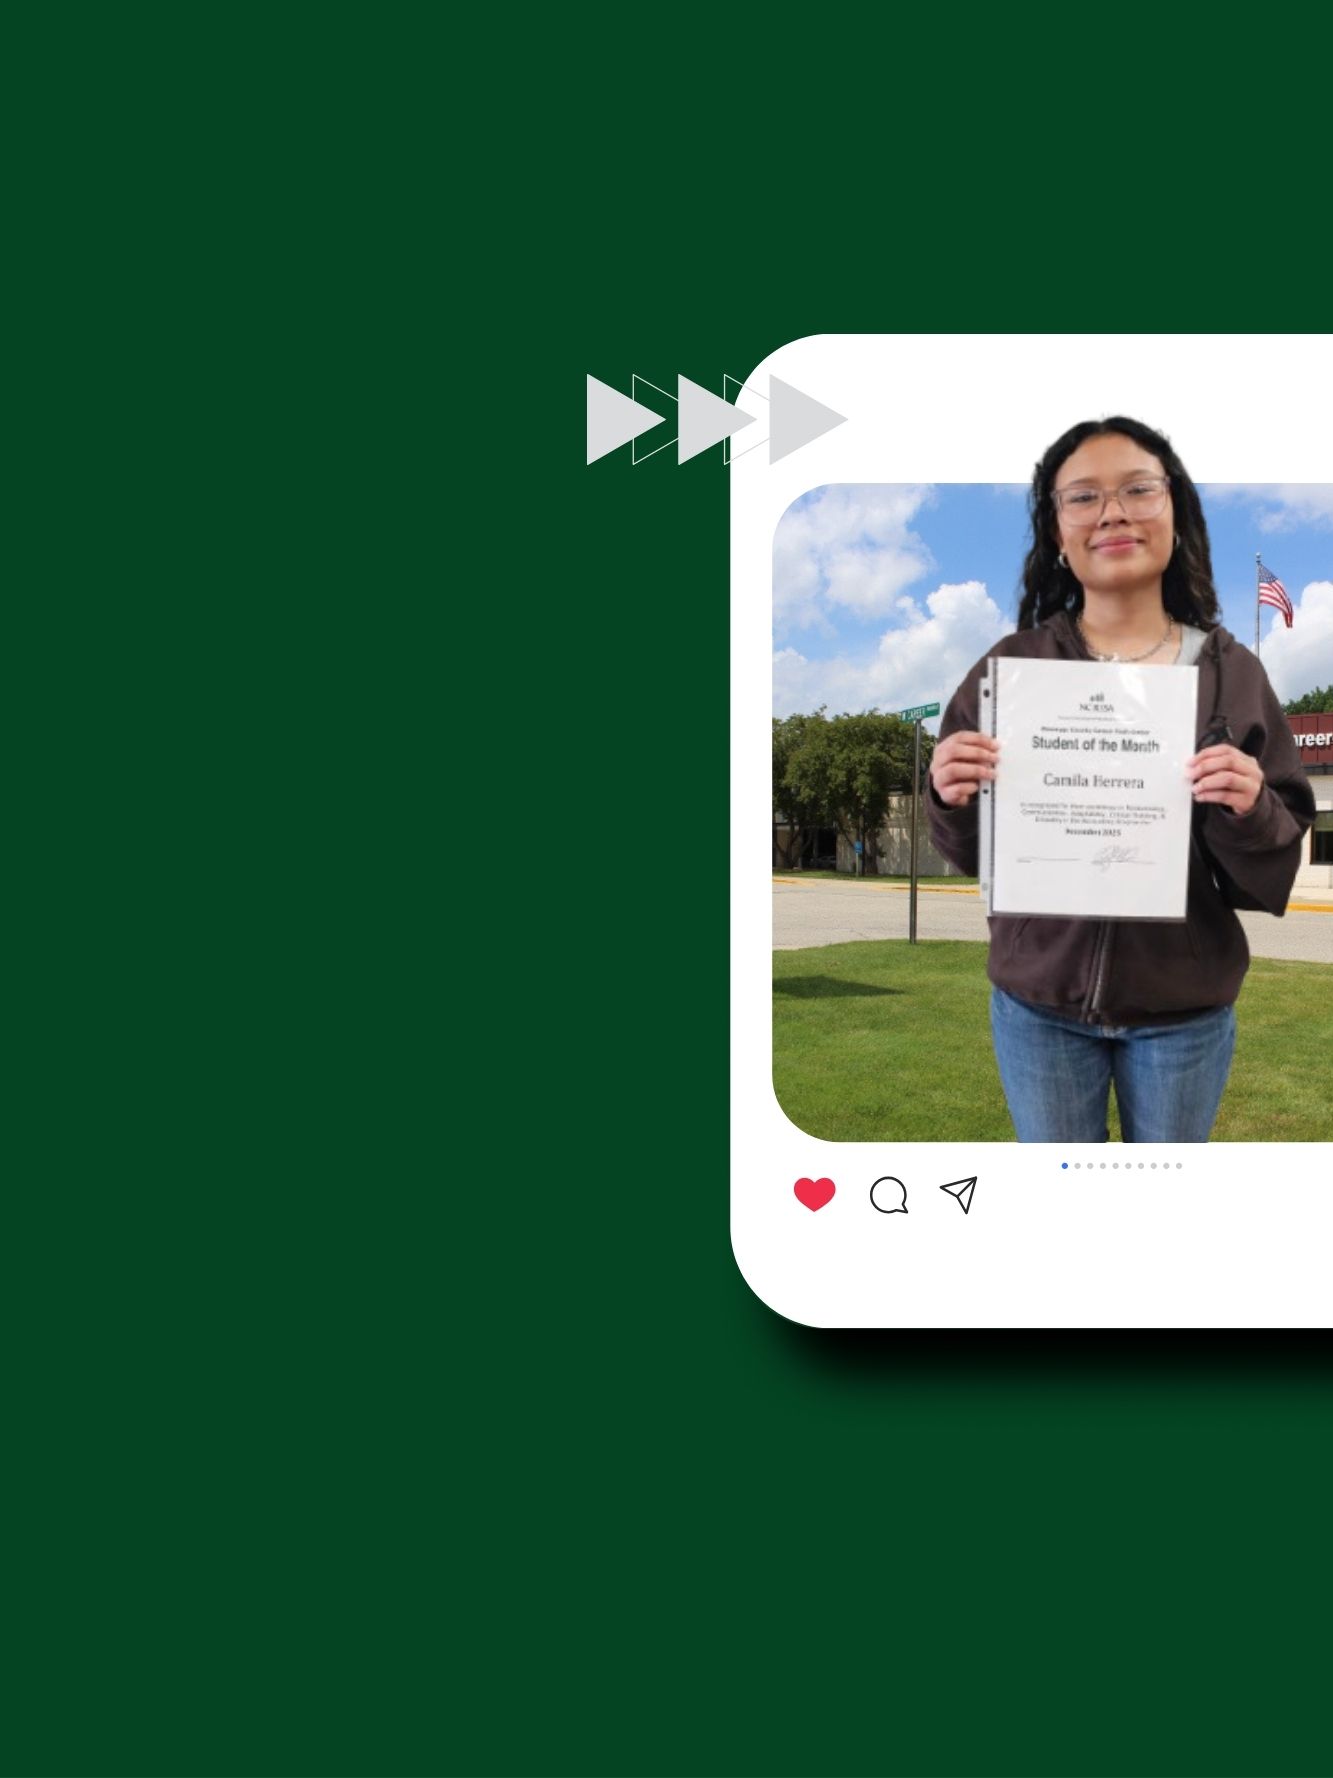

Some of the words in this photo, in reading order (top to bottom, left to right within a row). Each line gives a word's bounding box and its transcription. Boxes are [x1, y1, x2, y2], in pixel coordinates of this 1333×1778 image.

[1032, 736, 1079, 750] Student
[1082, 738, 1095, 751] of
[1099, 738, 1118, 752] the
[1121, 739, 1160, 753] Month
[1043, 773, 1089, 788] Camila
[1093, 774, 1144, 789] Herrera
